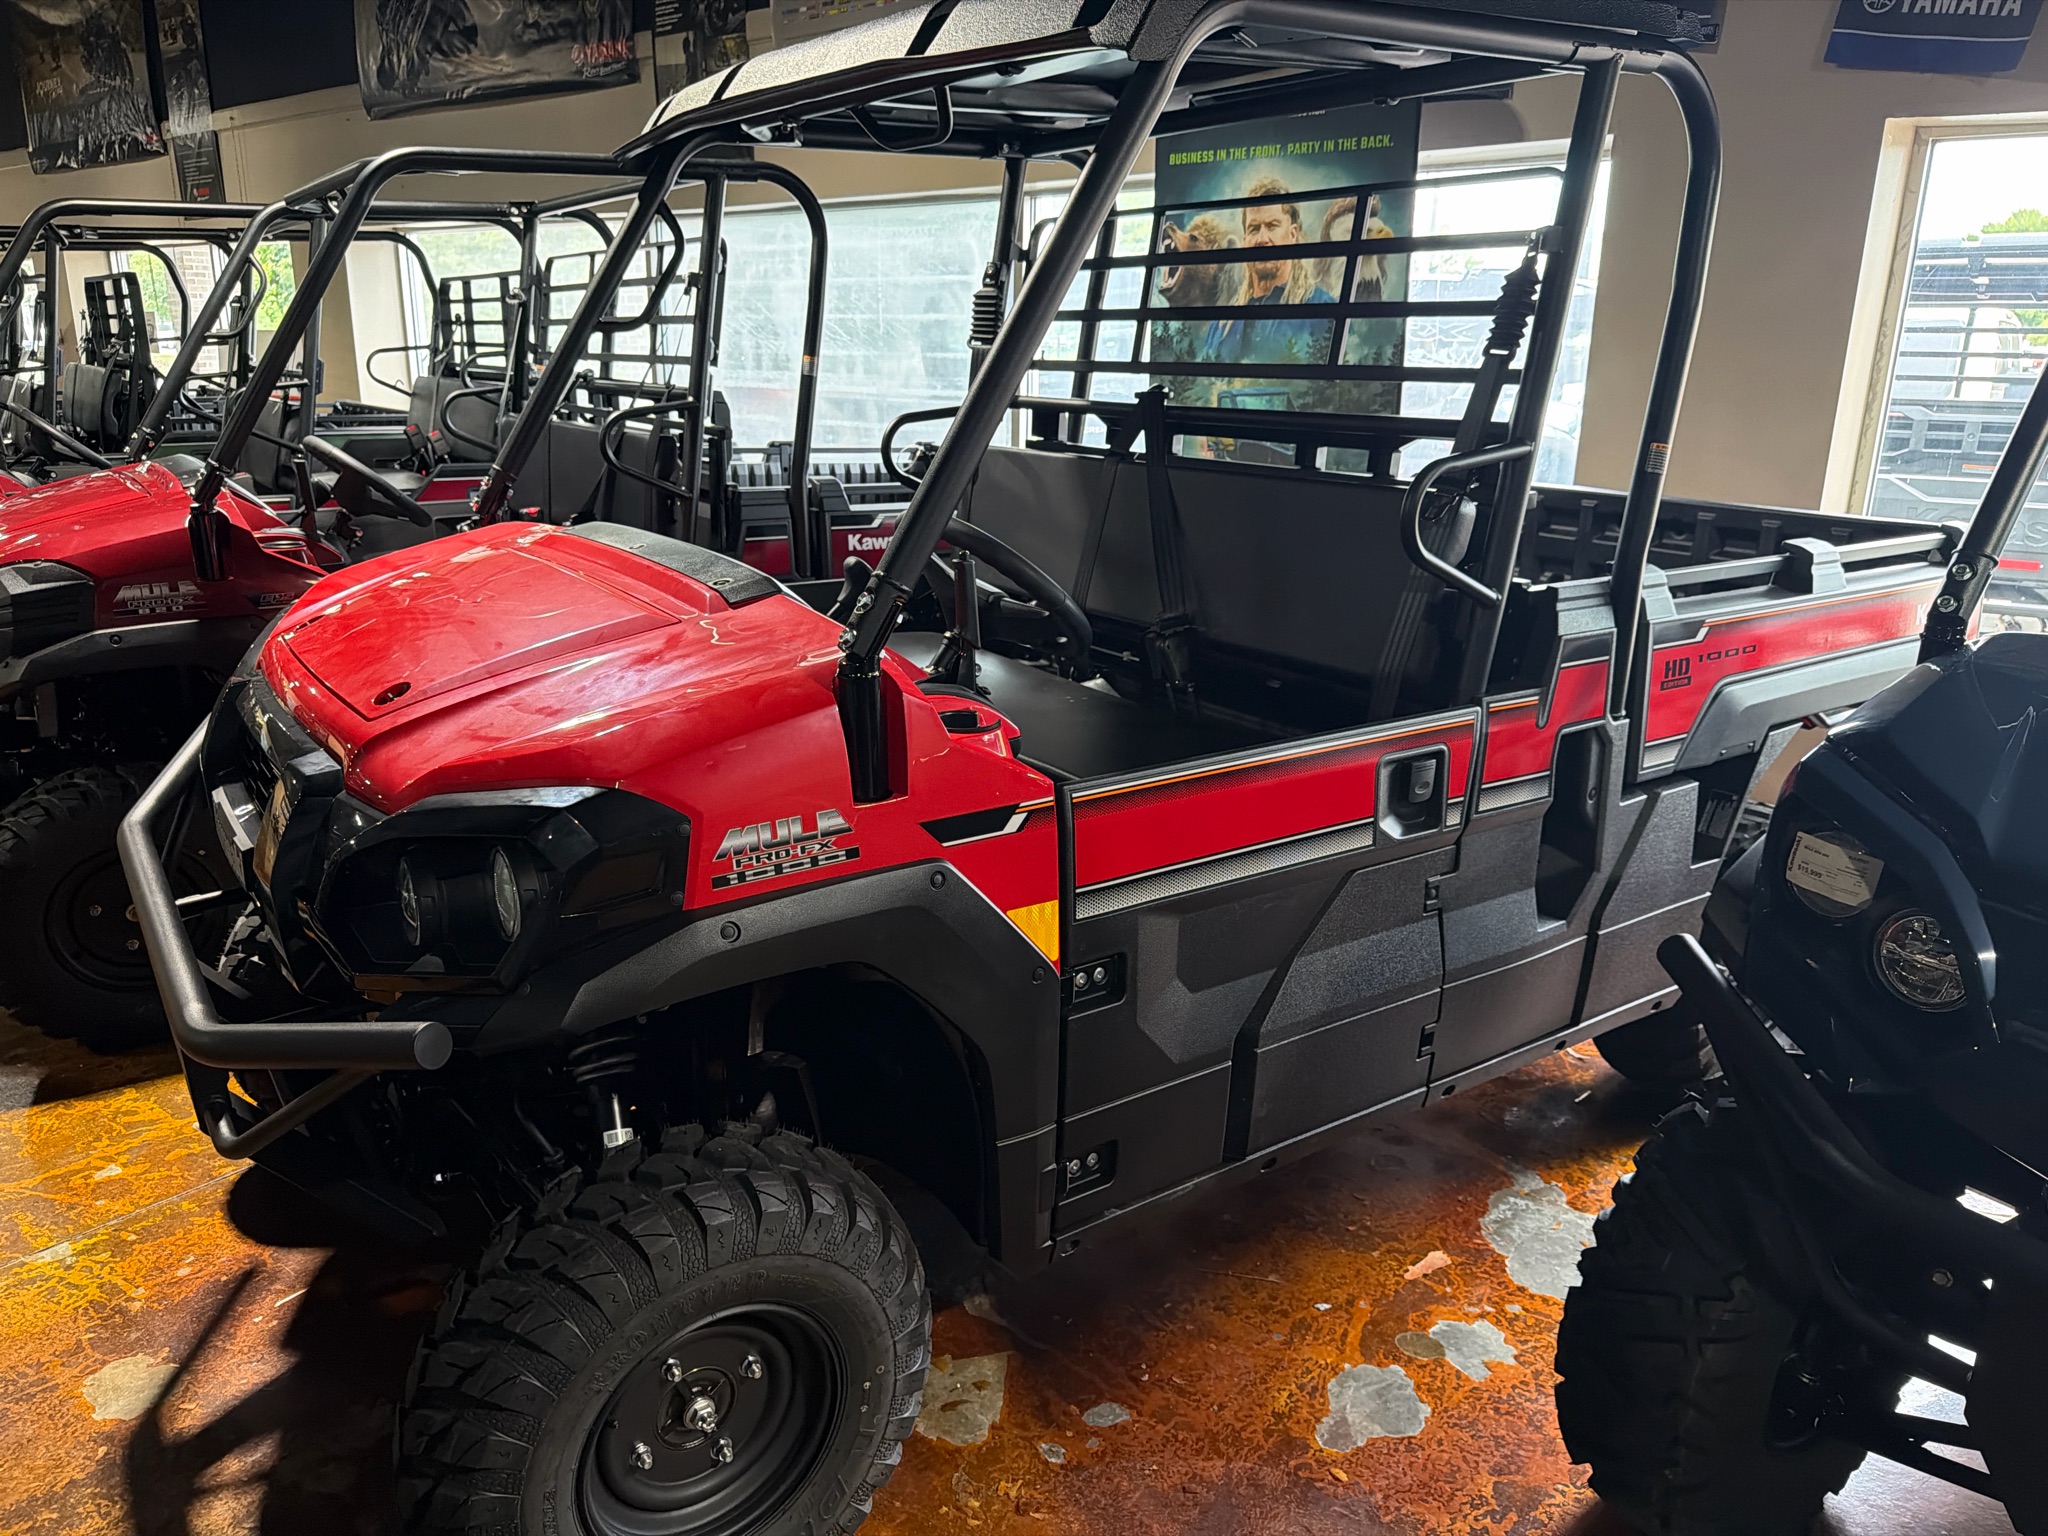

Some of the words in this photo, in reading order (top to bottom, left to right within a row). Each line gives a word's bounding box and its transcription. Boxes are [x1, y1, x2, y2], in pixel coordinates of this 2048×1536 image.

[1900, 0, 2022, 17] YAMAHA
[1169, 149, 1214, 166] BUSINESS
[1216, 148, 1227, 161] IN
[1229, 146, 1248, 160] THE
[1287, 141, 1321, 157] PARTY
[1323, 139, 1335, 153] IN
[1338, 137, 1358, 151] THE
[1360, 134, 1394, 149] BACK.
[847, 533, 893, 551] Kaw
[113, 580, 204, 602] MULE
[260, 592, 295, 604] EPS
[138, 605, 183, 615] 820
[1697, 644, 1757, 663] 1000
[1664, 657, 1691, 679] HD
[1662, 678, 1689, 690] EDITION
[712, 808, 855, 862] MULE
[734, 838, 838, 871] PRO-FX
[726, 850, 847, 885] 1000
